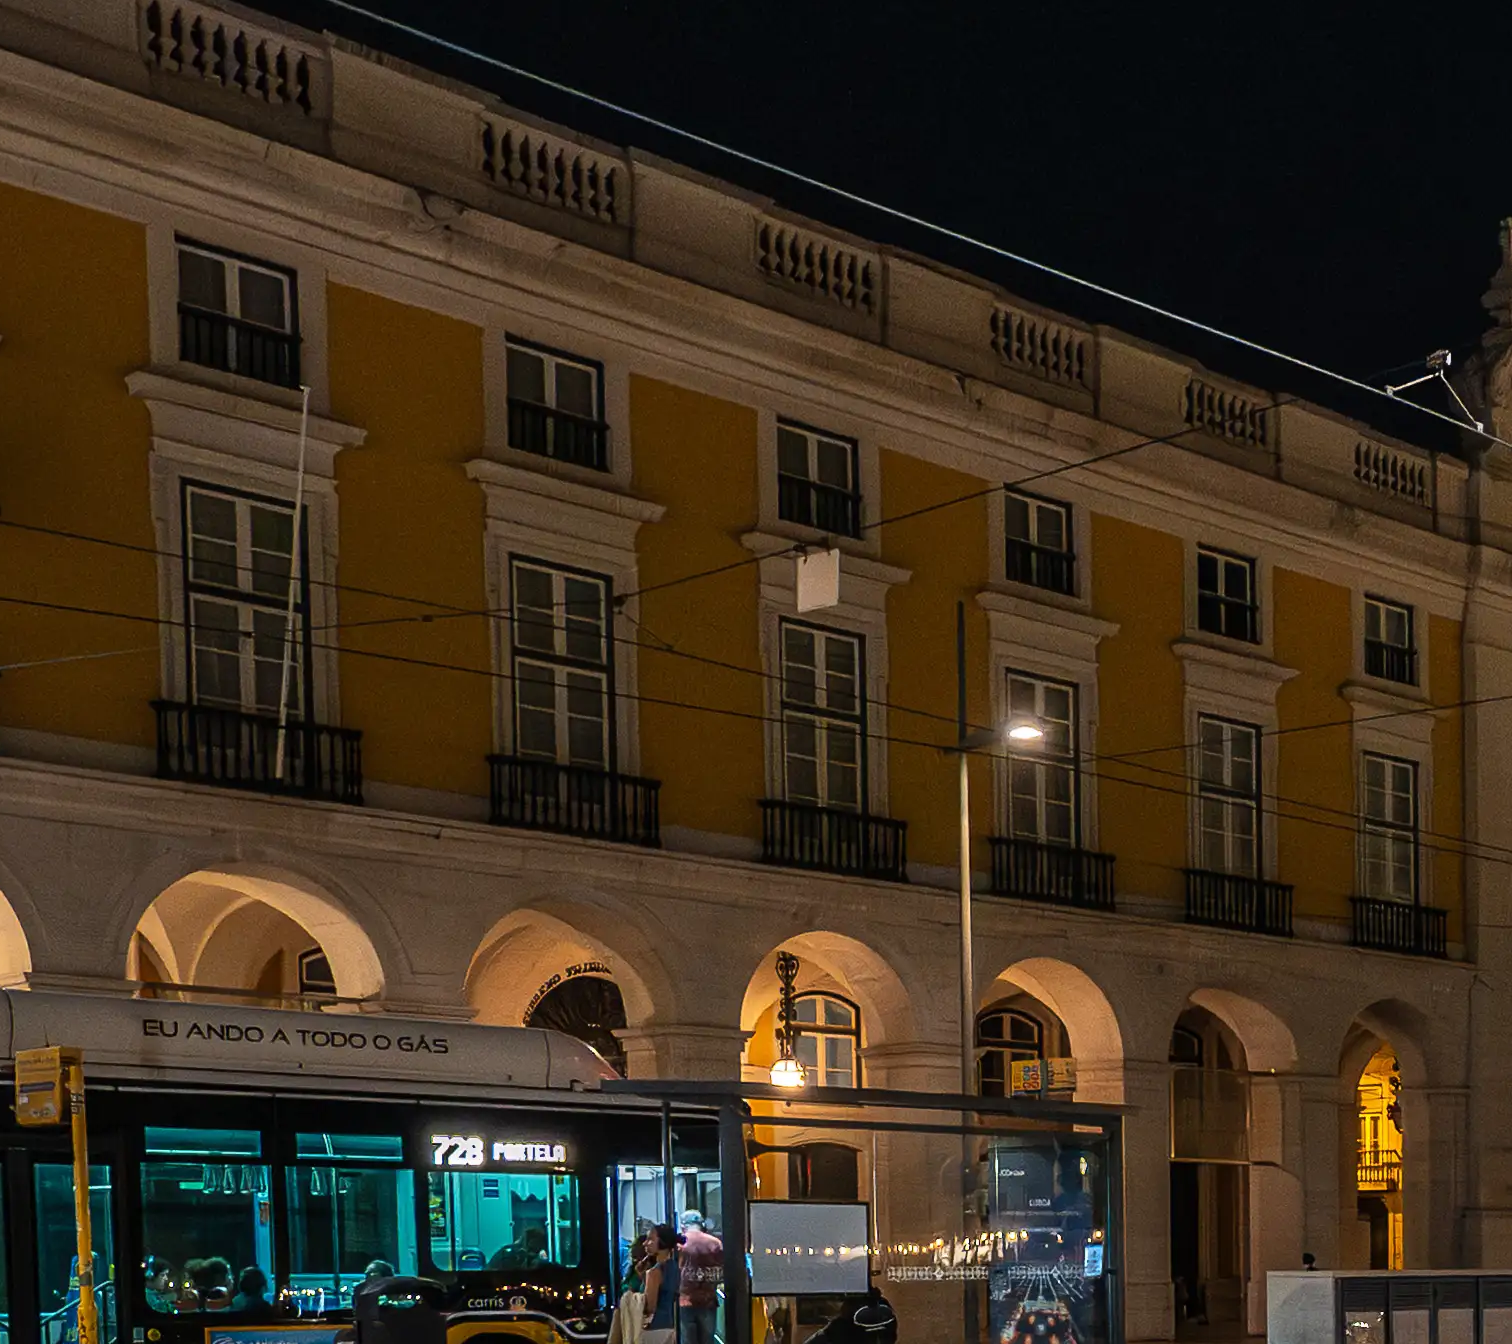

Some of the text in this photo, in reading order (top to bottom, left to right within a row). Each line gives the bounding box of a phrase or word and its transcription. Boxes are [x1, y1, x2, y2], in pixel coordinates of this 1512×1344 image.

[142, 1019, 178, 1037] EU
[186, 1023, 265, 1042] ANDO
[270, 1028, 290, 1045] A
[296, 1029, 367, 1049] TODO
[372, 1035, 391, 1050] O
[431, 1135, 484, 1165] 728
[468, 1296, 504, 1308] carris
